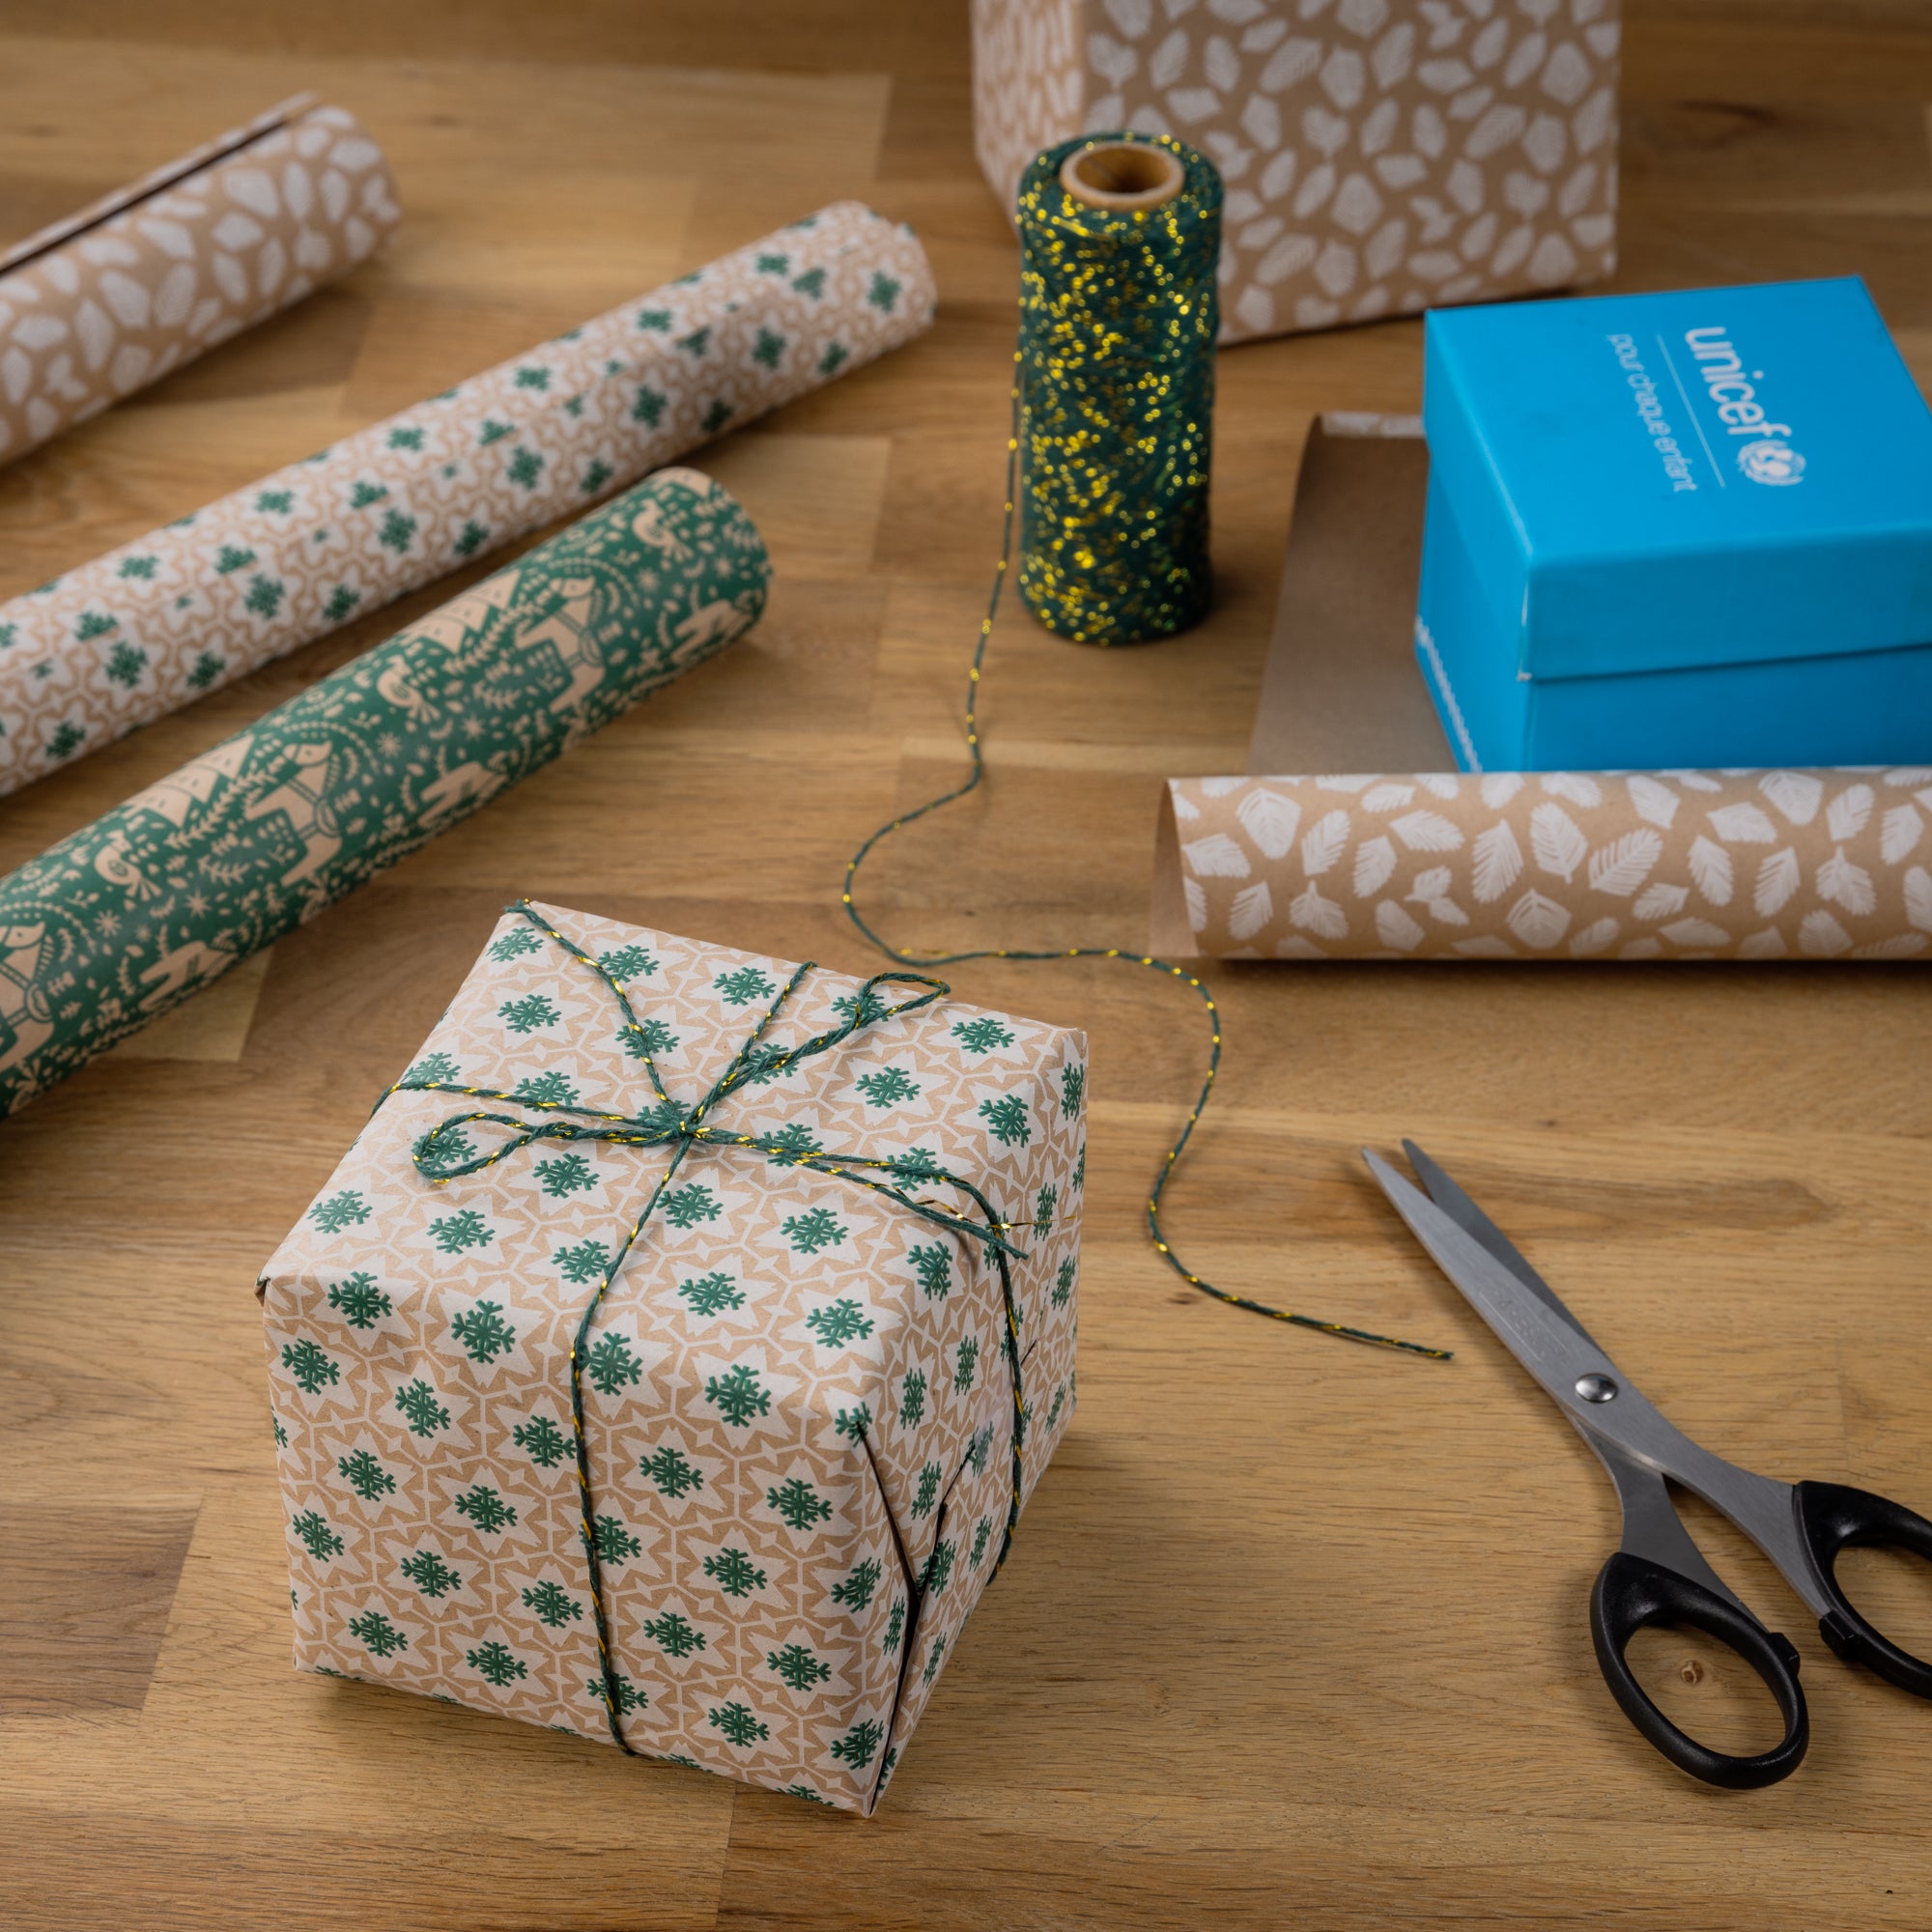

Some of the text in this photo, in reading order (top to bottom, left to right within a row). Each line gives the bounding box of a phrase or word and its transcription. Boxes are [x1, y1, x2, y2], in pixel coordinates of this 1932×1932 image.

[1605, 333, 1697, 492] pour chaque enfant
[1685, 327, 1792, 437] unicef
